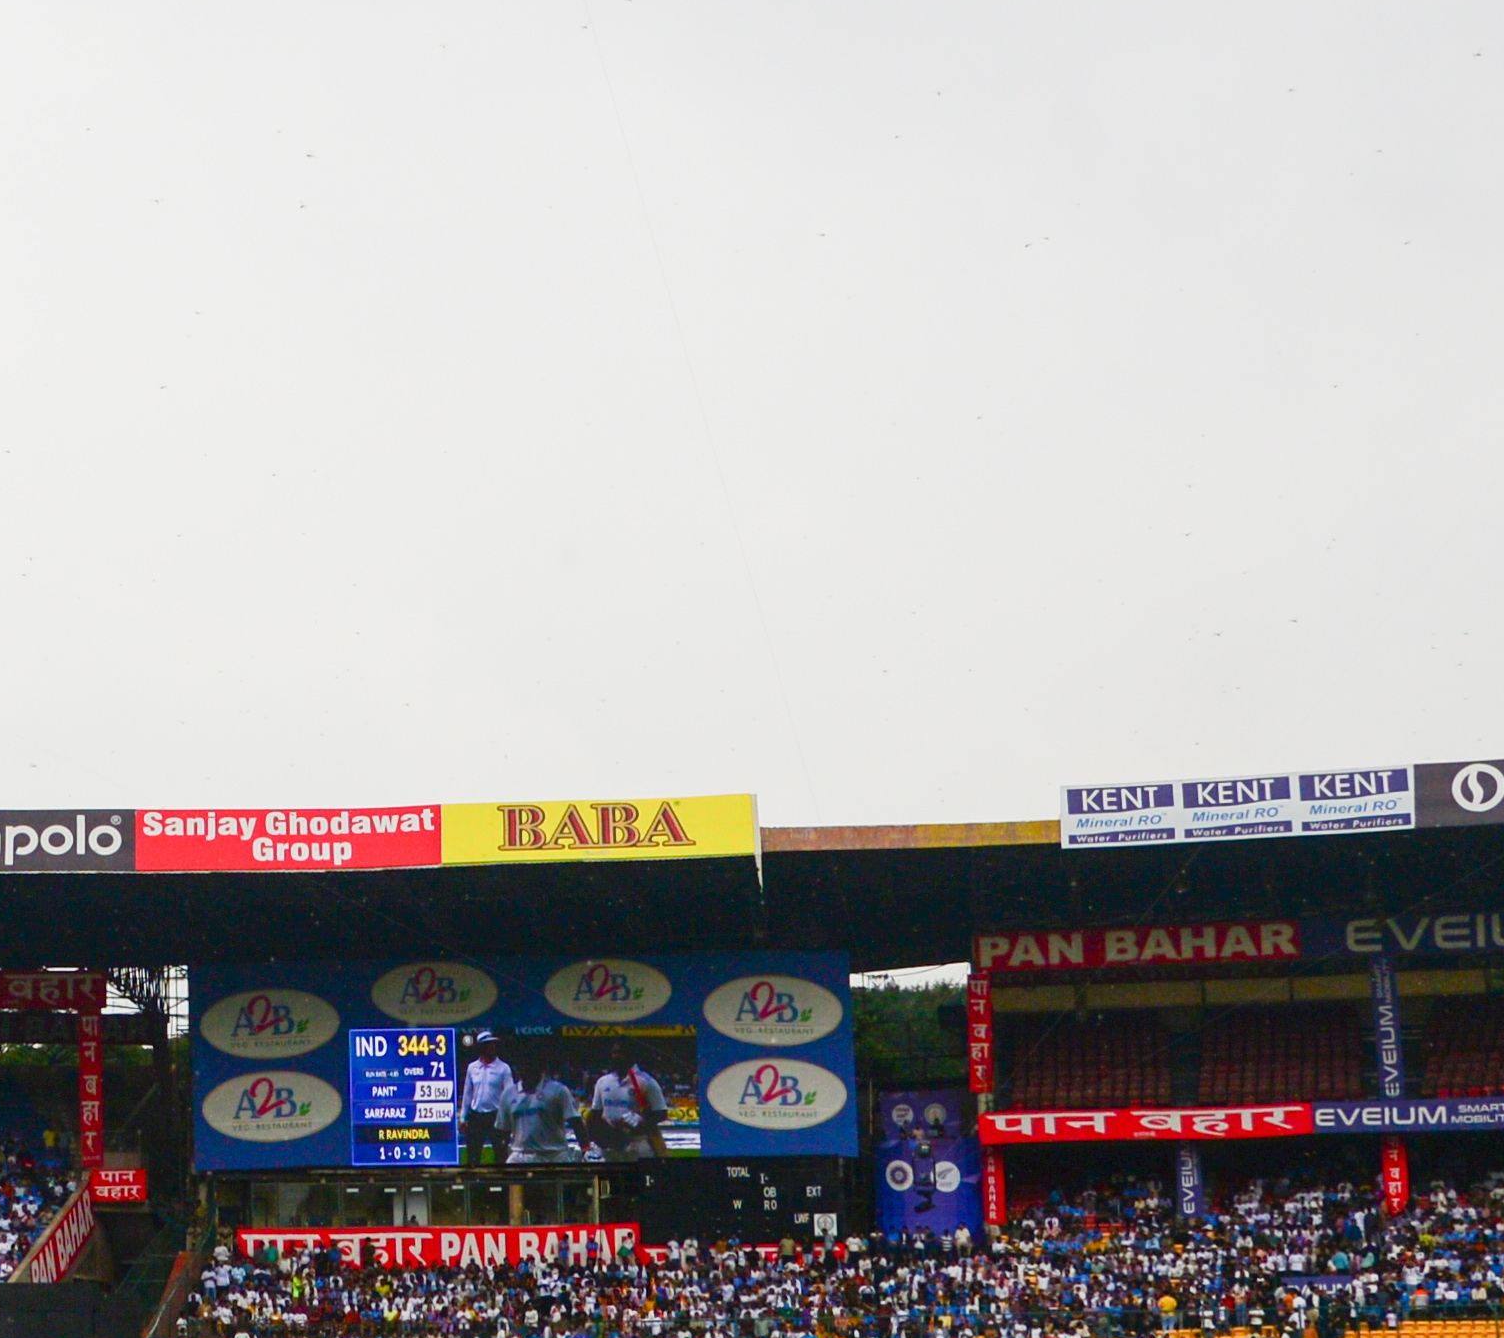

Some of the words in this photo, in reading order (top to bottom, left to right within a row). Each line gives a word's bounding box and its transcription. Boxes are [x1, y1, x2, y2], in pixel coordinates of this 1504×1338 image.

[1195, 777, 1275, 807] KENT
[1313, 771, 1392, 799] KENT
[1080, 786, 1160, 813] KENT
[142, 812, 257, 841] Sanjay
[264, 806, 435, 838] Ghodawat
[496, 801, 697, 851] BABA
[251, 837, 353, 864] Group
[979, 933, 1083, 968] PAN
[1105, 925, 1295, 962] BAHAR
[736, 981, 799, 1022] A2B
[355, 1036, 387, 1057] IND
[398, 1034, 447, 1056] 344-3
[404, 1067, 424, 1076] OVERS
[430, 1061, 446, 1077] 71
[233, 1077, 297, 1119] A2B
[420, 1085, 432, 1097] 53
[434, 1088, 449, 1098] (56)
[739, 1064, 802, 1105] A2B
[364, 1108, 406, 1119] SARFARAZ
[418, 1108, 433, 1119] 125
[761, 1110, 817, 1118] RESTAURANT
[991, 1110, 1116, 1138] पान
[1130, 1105, 1304, 1137] बहार
[1315, 1106, 1447, 1128] EVEIUM
[386, 1129, 430, 1140] RAVINDRA
[100, 1171, 134, 1185] पान
[726, 1166, 750, 1178] TOTAL
[763, 1186, 776, 1198] OB
[806, 1186, 822, 1197] EXT
